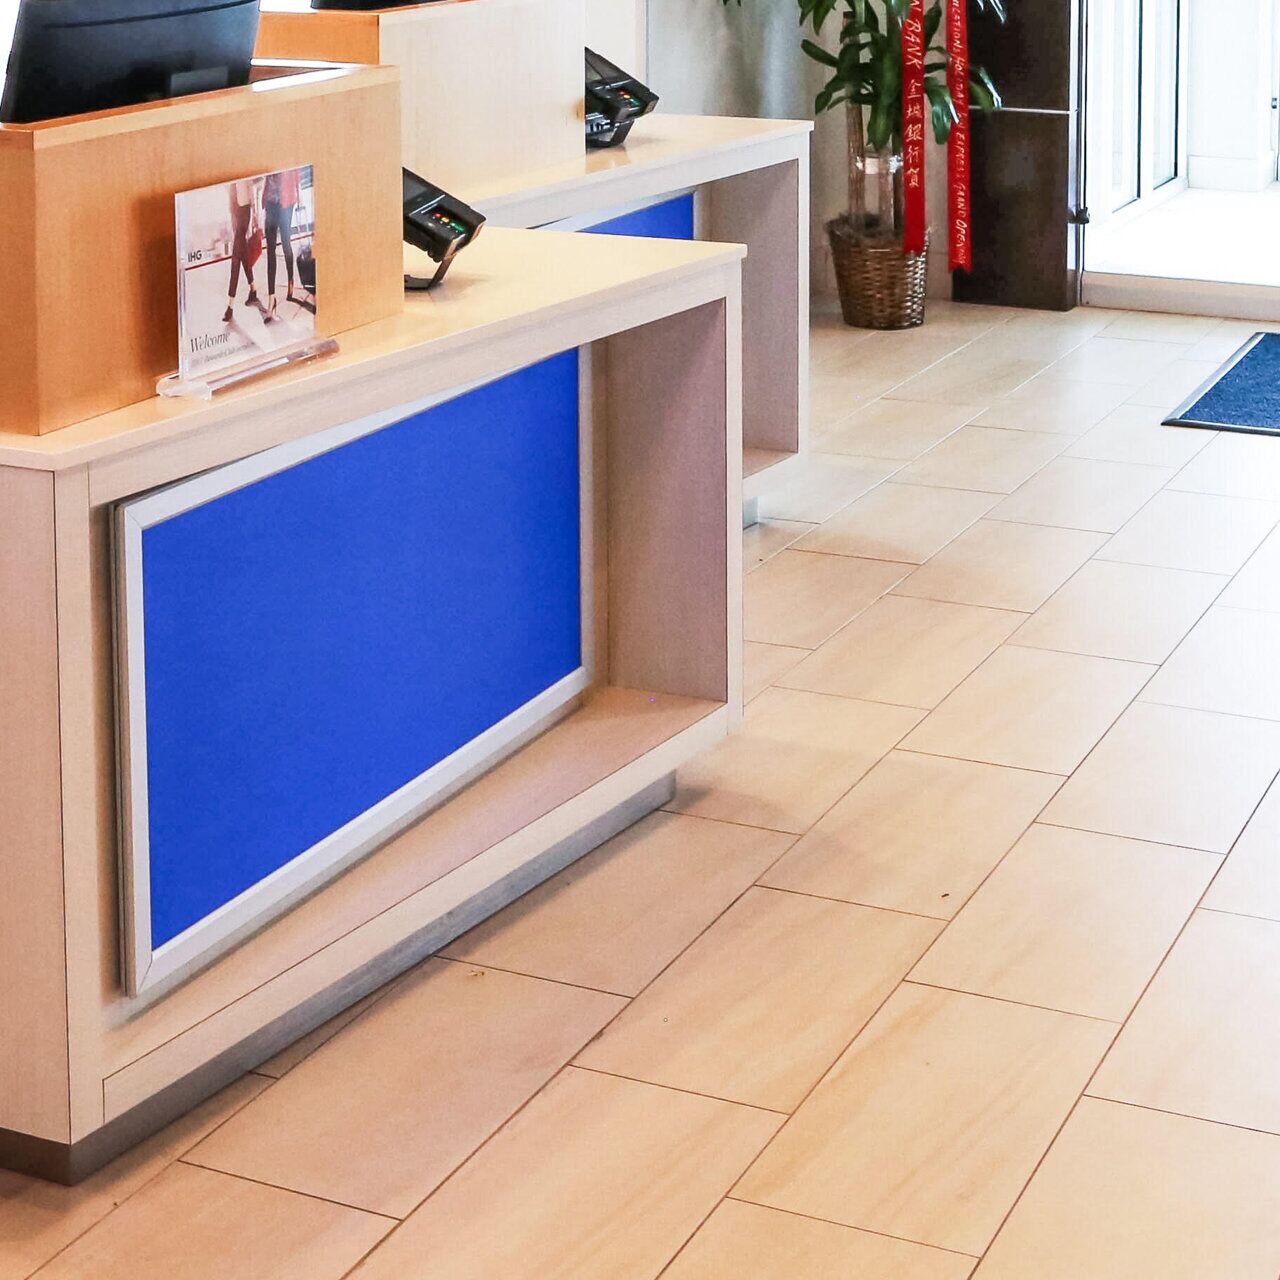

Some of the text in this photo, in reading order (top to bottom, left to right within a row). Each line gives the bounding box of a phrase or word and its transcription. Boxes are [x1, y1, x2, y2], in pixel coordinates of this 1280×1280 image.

[905, 19, 922, 70] BANK
[953, 183, 966, 218] GRAND
[188, 250, 202, 262] IHG
[952, 219, 968, 264] OPENING
[190, 332, 231, 353] Welcome
